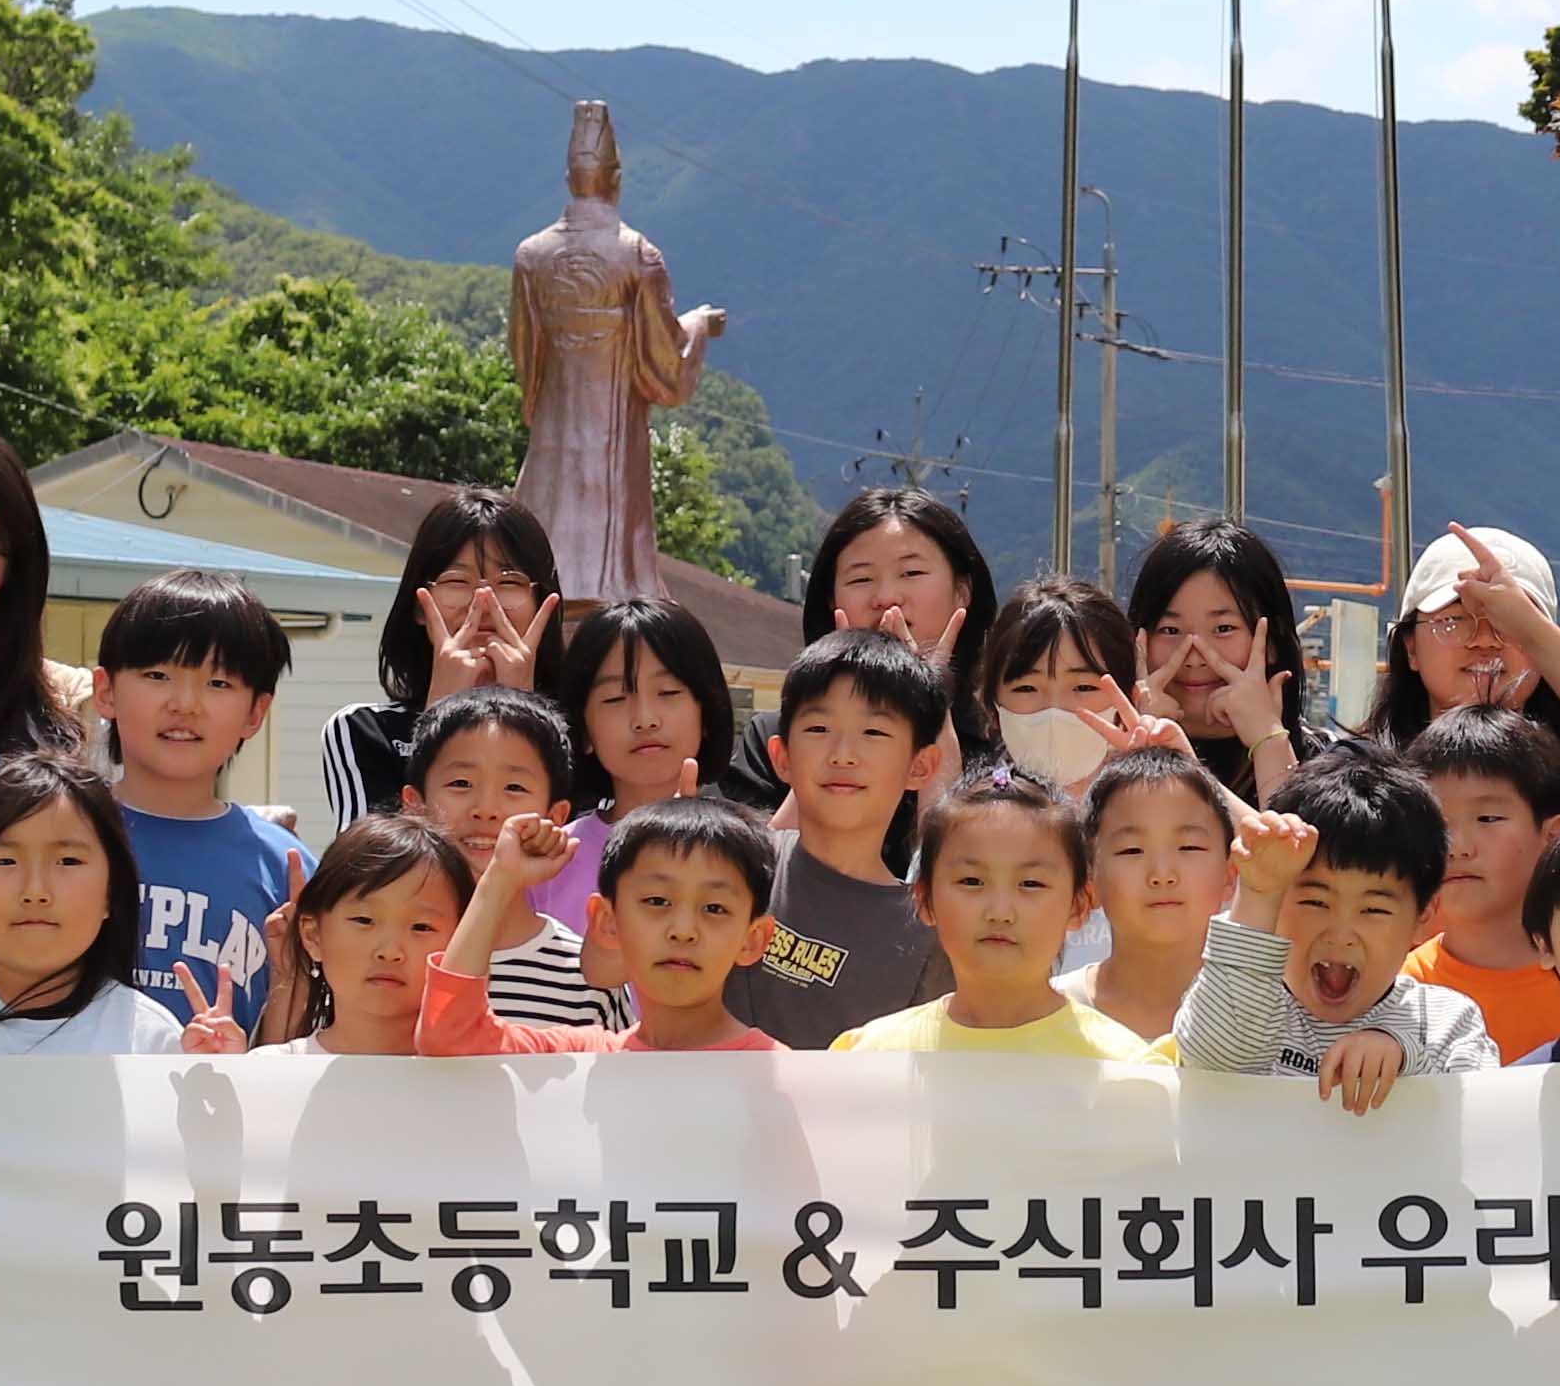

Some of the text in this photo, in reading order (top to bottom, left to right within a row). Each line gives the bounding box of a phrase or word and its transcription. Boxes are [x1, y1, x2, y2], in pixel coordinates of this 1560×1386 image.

[790, 939, 841, 980] RULES
[97, 1197, 750, 1316] 원동초등학교
[781, 1200, 868, 1300] &
[893, 1195, 1334, 1311] 주식회사
